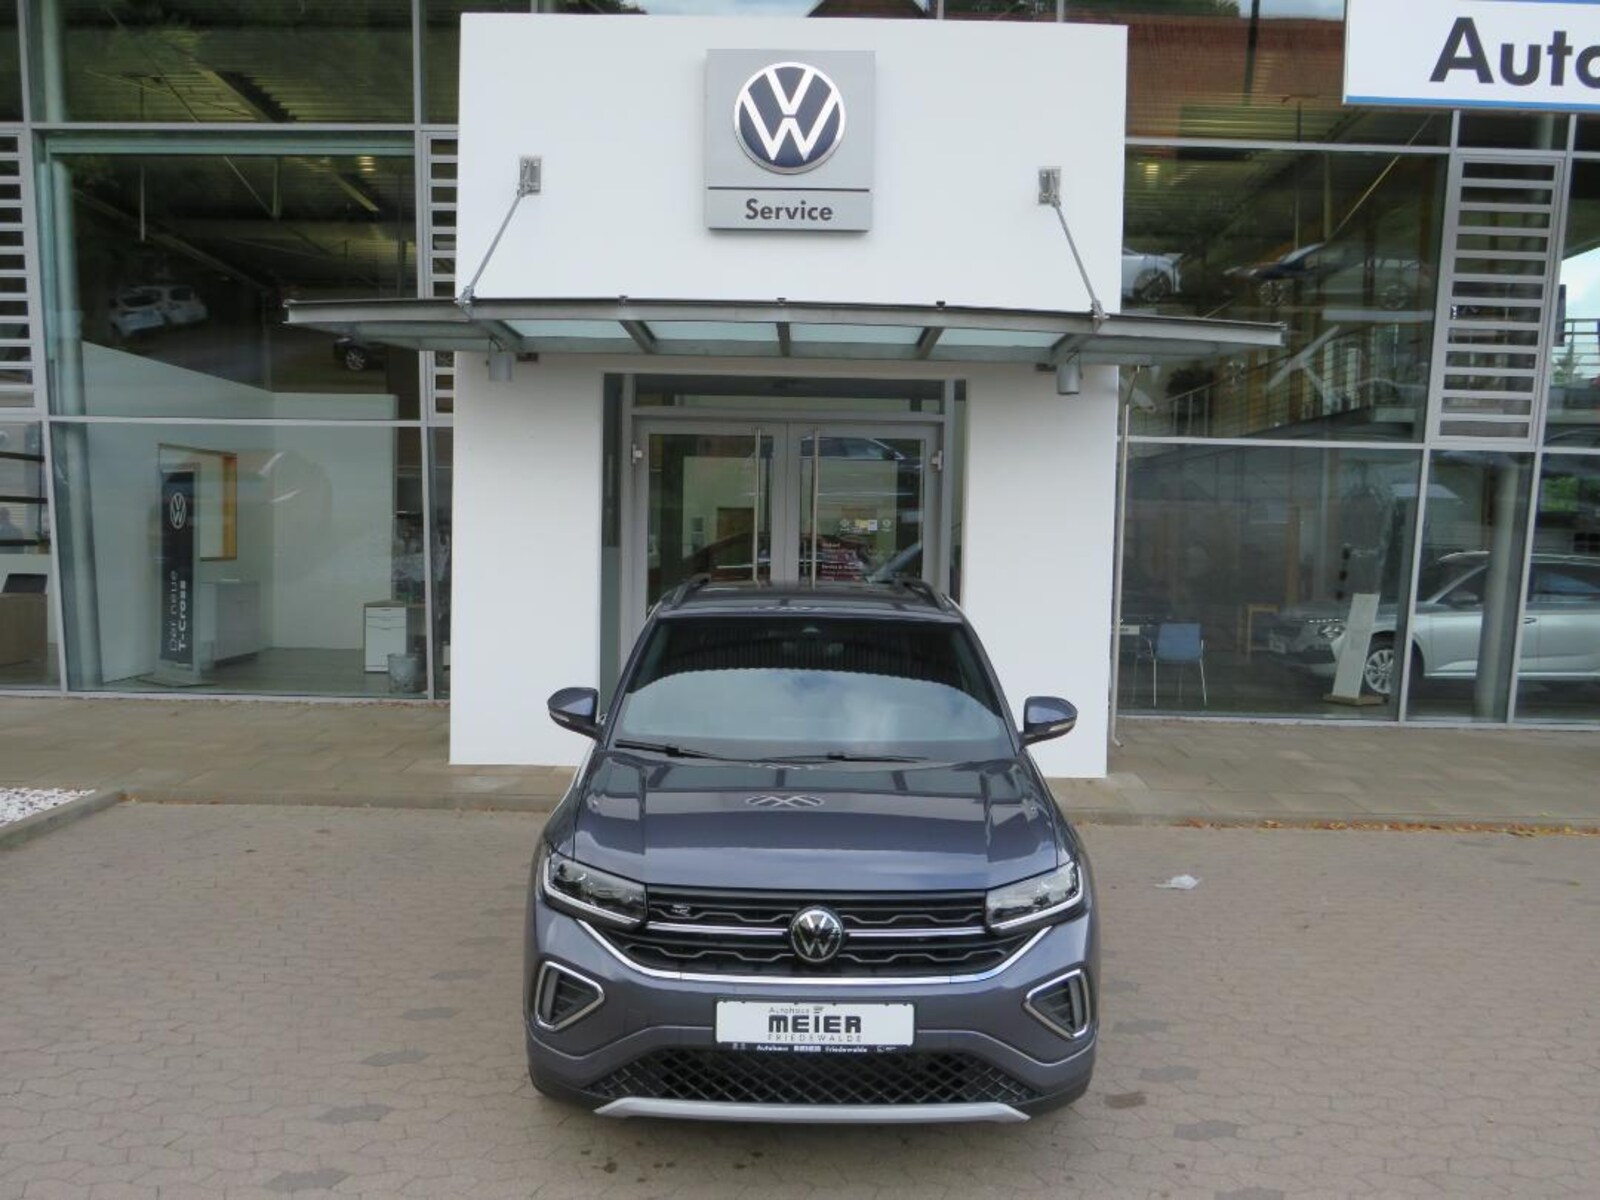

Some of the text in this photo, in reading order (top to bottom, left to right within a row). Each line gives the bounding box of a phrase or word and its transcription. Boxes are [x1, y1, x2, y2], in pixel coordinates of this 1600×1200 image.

[734, 62, 846, 174] VW
[745, 198, 833, 221] Service
[178, 580, 187, 651] T-Cross
[768, 1034, 862, 1042] FRIEDEWALDE
